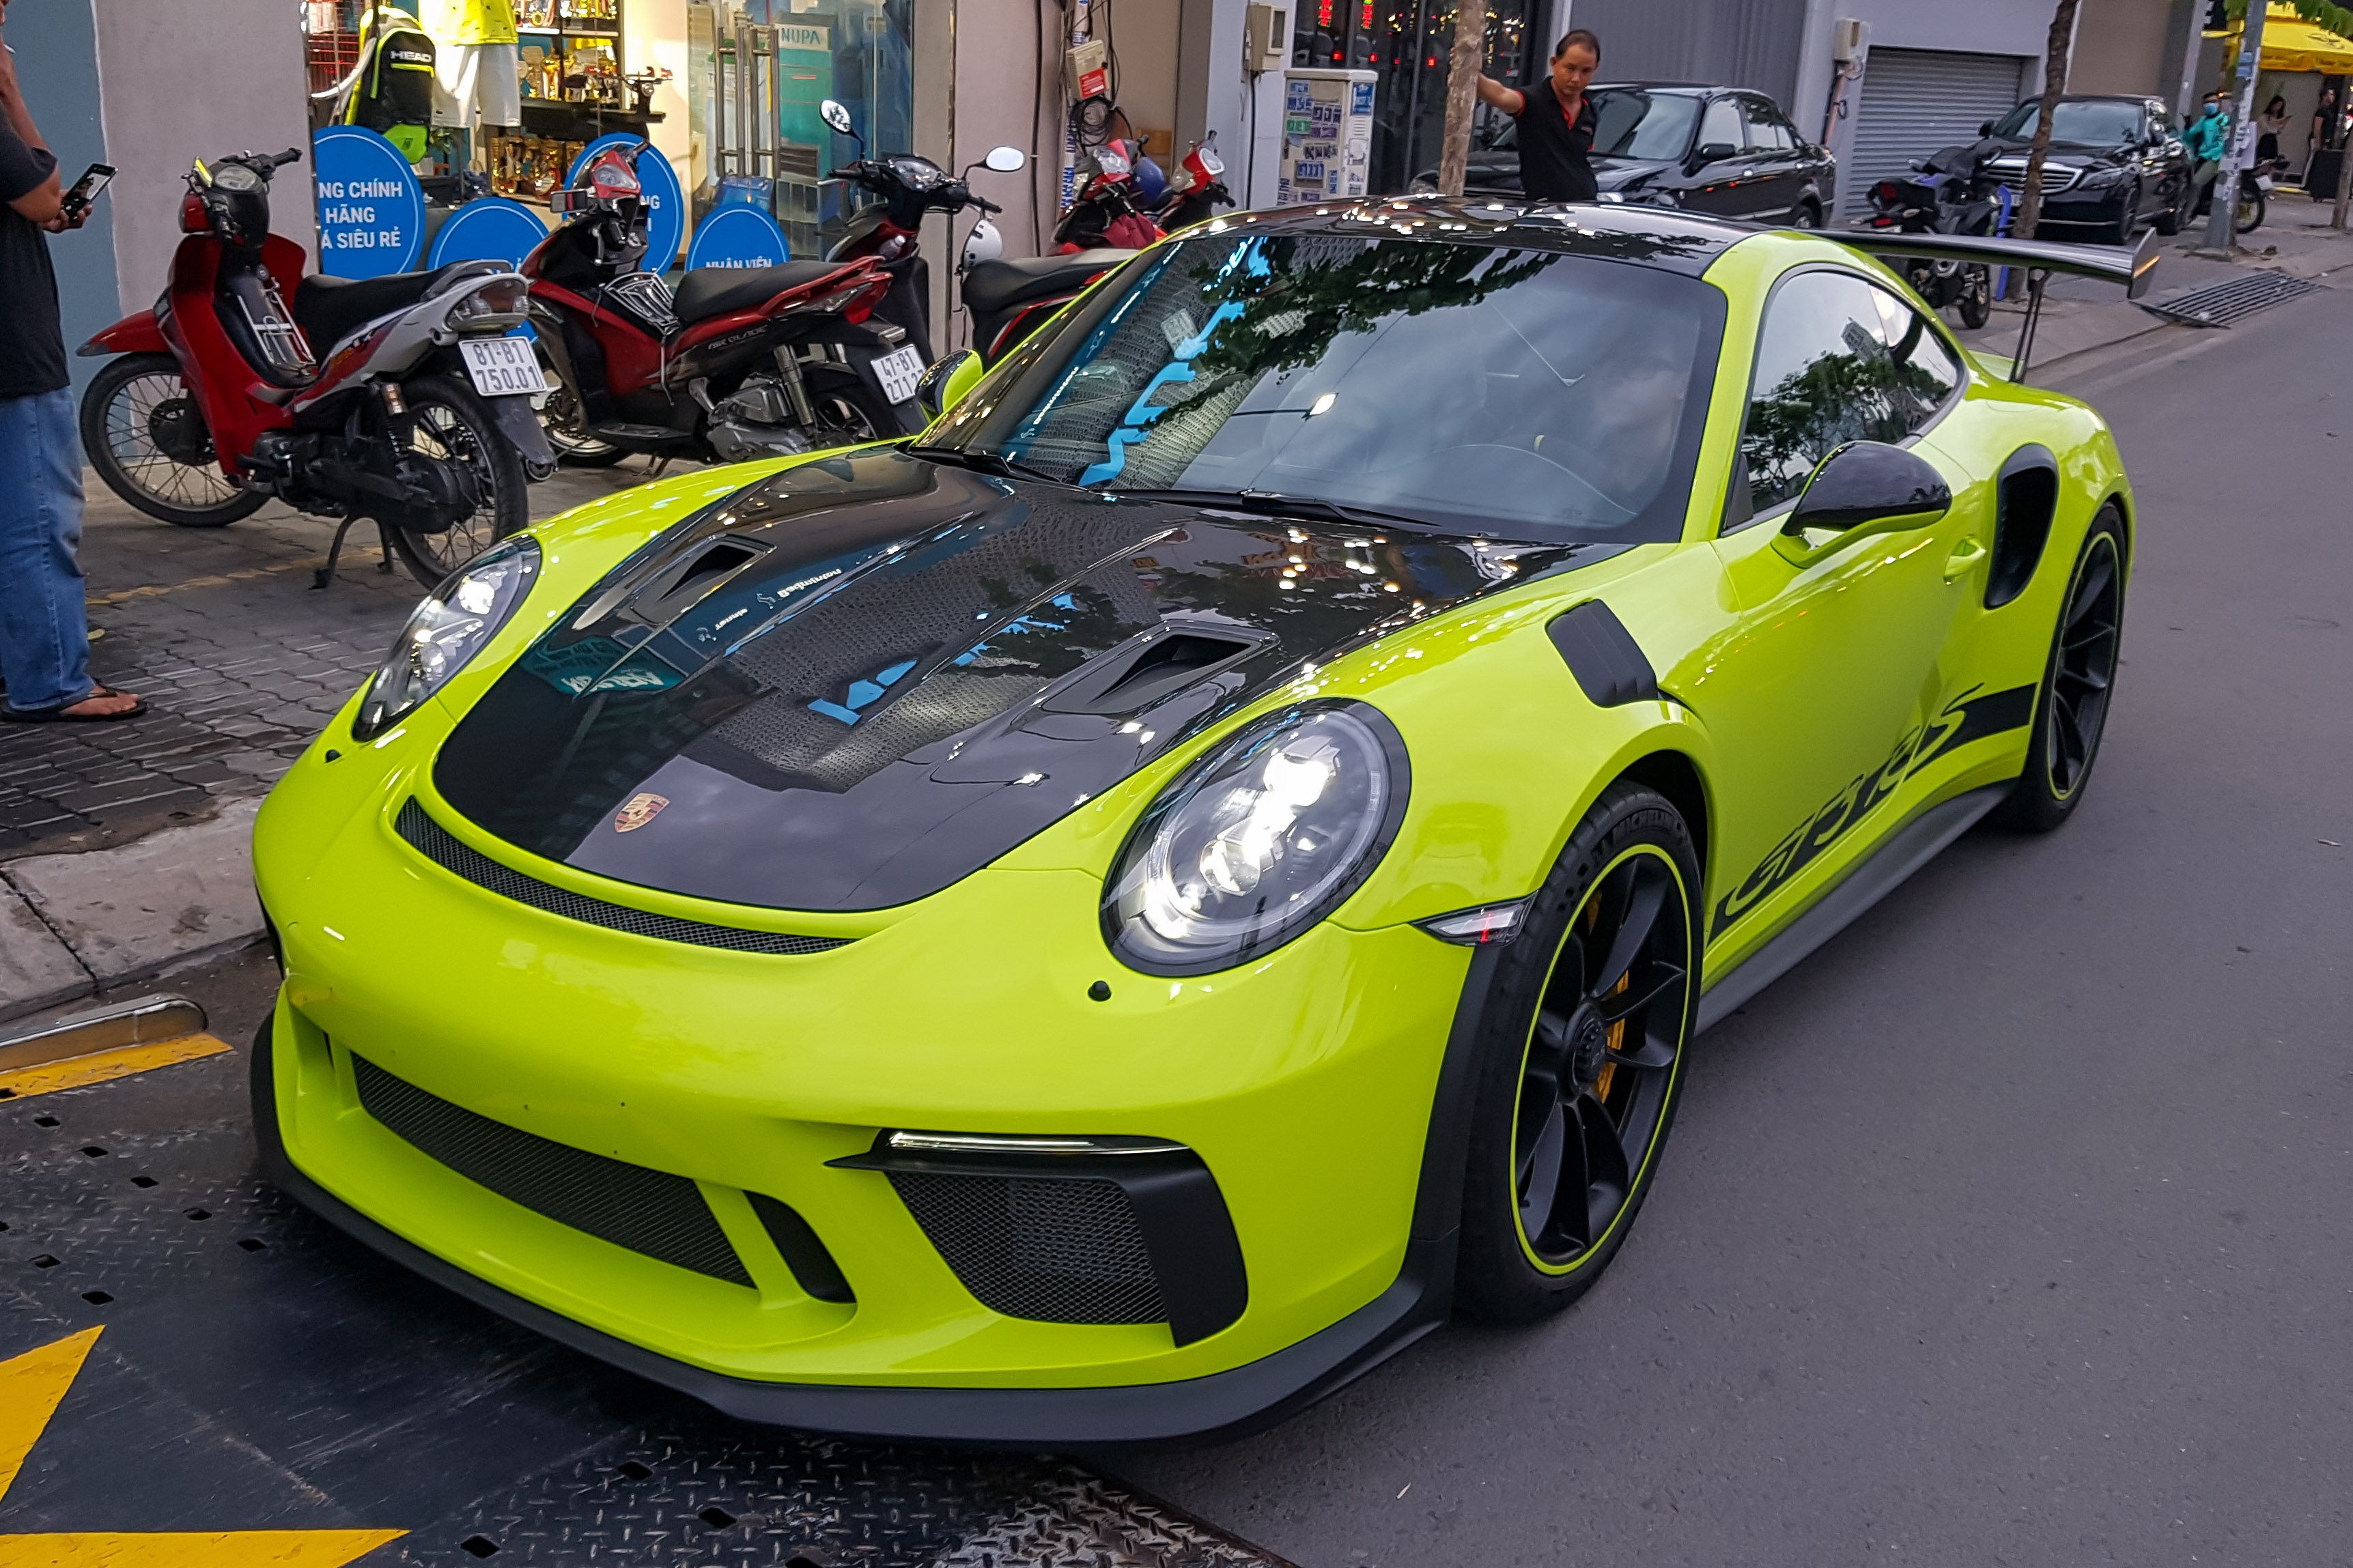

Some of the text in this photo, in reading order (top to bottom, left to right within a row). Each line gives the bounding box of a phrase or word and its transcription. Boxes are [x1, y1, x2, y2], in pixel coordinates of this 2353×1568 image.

[782, 28, 821, 44] NUPA
[390, 51, 432, 63] HEAD
[349, 177, 403, 198] CHÍNH
[325, 203, 376, 224] HÃNG
[337, 229, 375, 249] SIÊU
[379, 226, 401, 247] RẺ
[473, 341, 524, 366] 81-B1
[476, 366, 540, 392] 750.01
